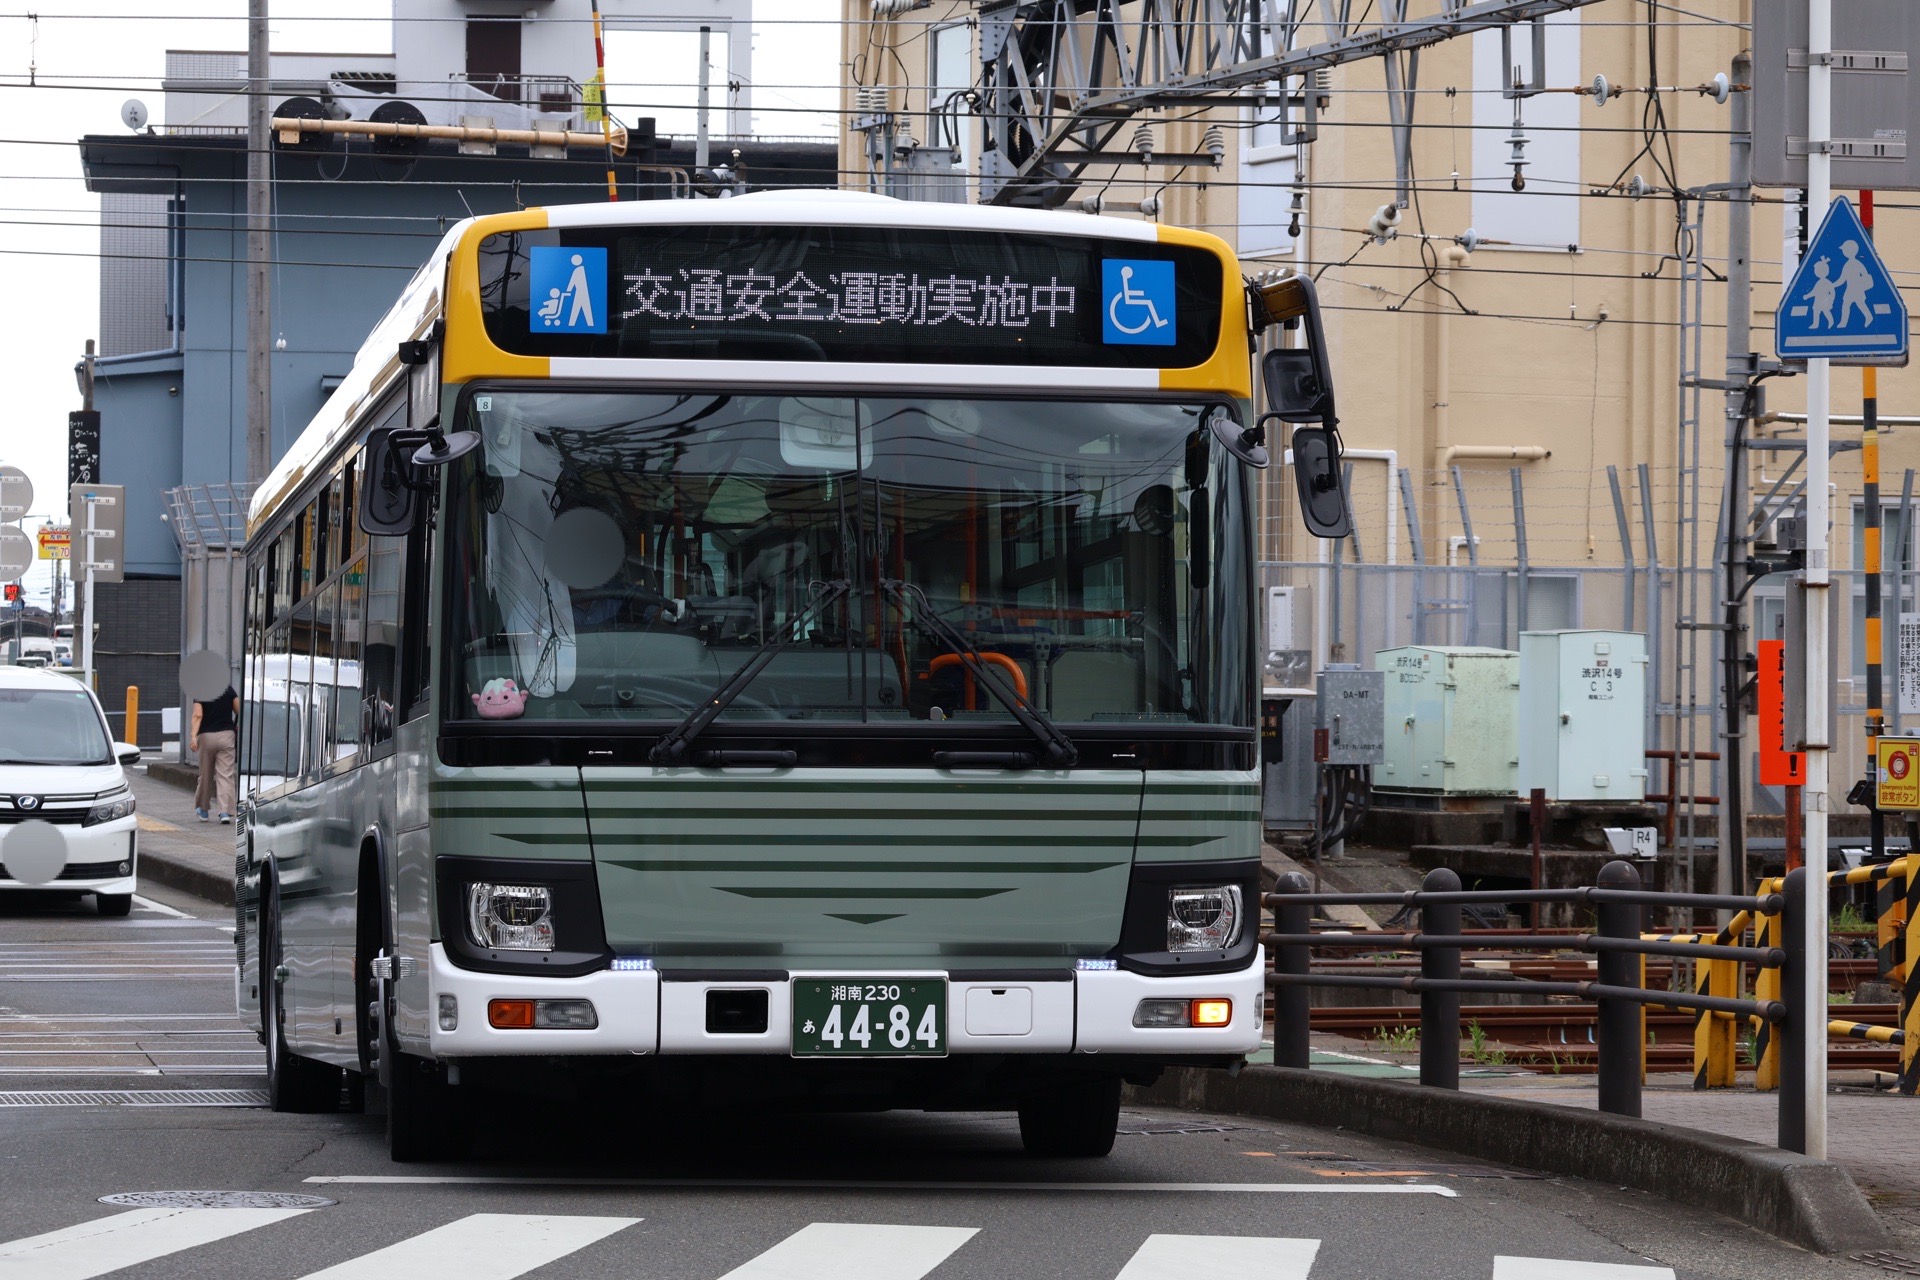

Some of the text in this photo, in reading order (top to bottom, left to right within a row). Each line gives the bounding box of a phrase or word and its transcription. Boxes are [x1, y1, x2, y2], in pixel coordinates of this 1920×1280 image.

[621, 267, 1076, 328] 交通安全運動実施中
[482, 401, 489, 410] 8
[1582, 668, 1622, 679] 渋沢14号
[1590, 681, 1613, 692] C 3
[1343, 690, 1370, 699] DA-MT
[1881, 791, 1916, 803] 非常ボタン
[1637, 831, 1651, 844] R4
[802, 1004, 939, 1049] あ 44-84
